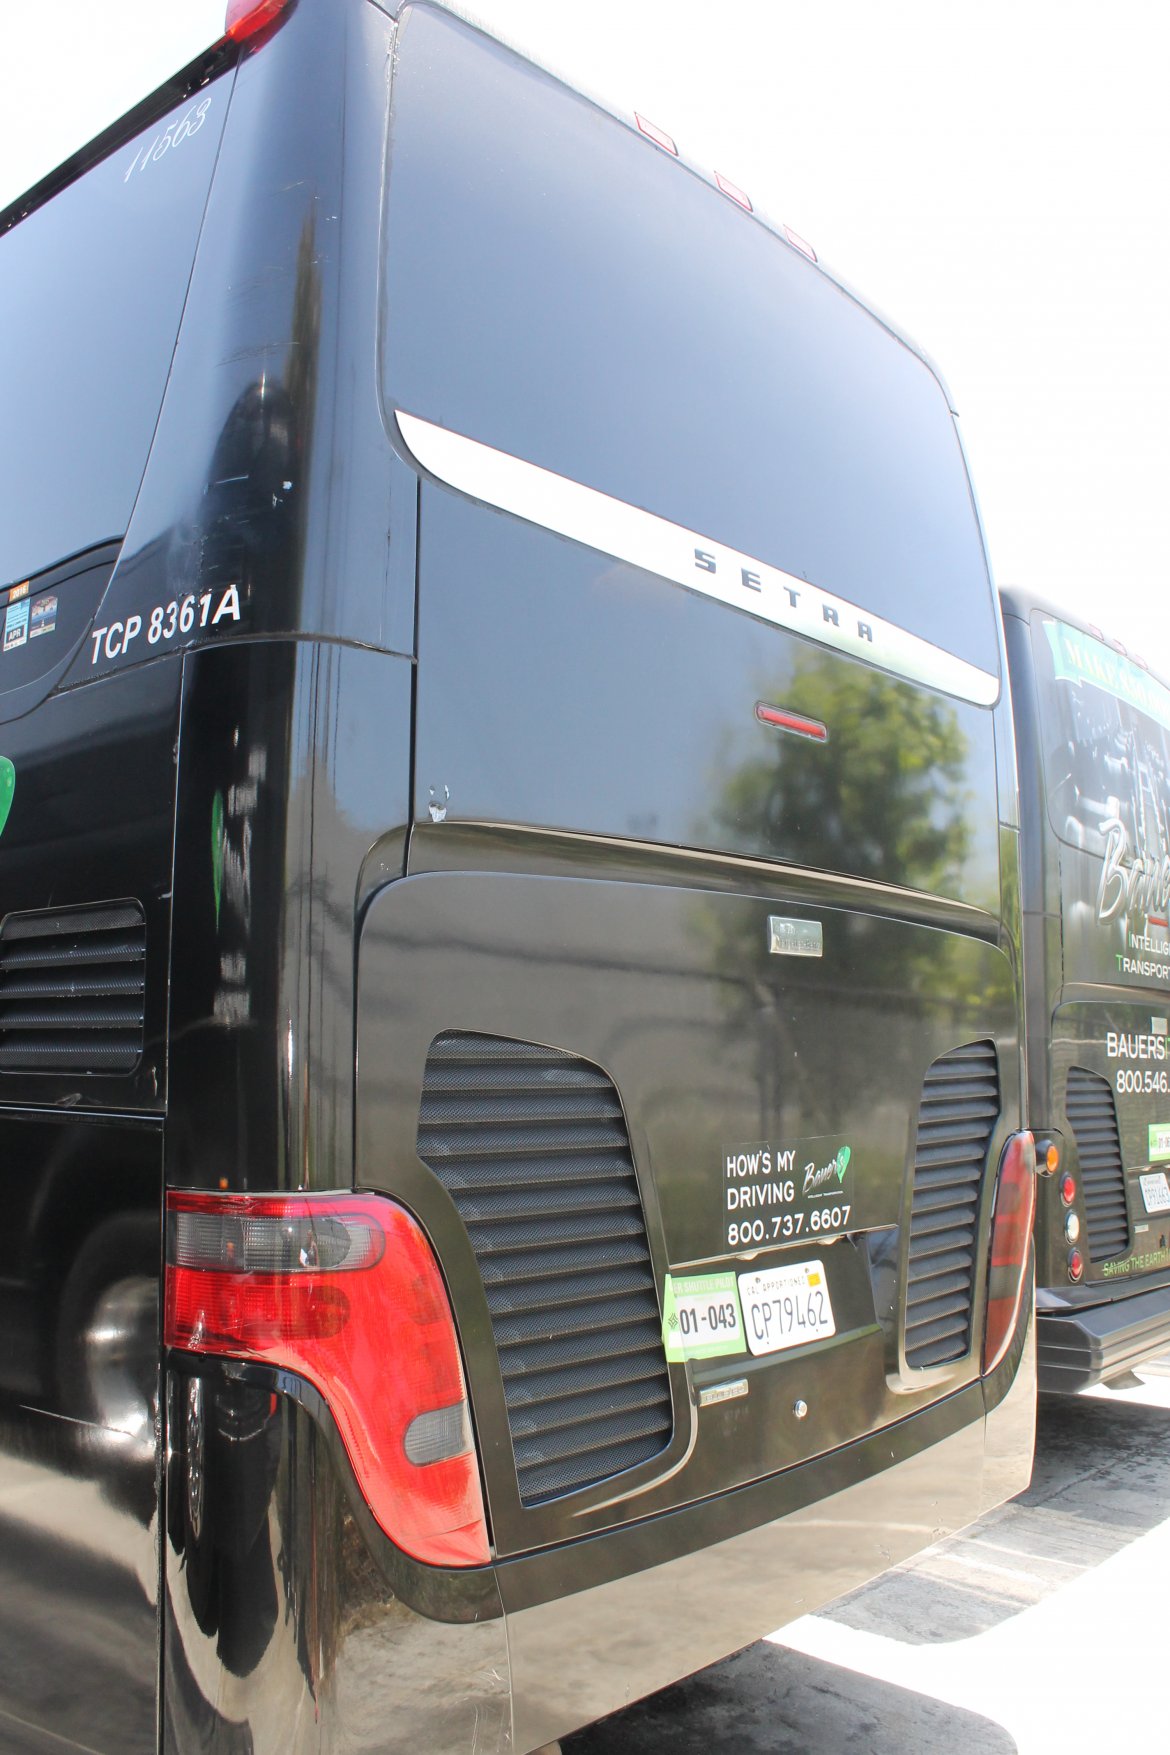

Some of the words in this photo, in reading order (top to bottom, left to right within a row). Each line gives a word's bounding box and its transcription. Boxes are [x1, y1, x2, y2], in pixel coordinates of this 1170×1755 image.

[124, 98, 212, 183] 11563
[694, 548, 873, 642] SETRA
[92, 615, 142, 664] TCP
[148, 584, 240, 644] 8361A
[1128, 931, 1170, 956] INTELLIG
[726, 1150, 771, 1178] HOW'S
[777, 1150, 796, 1172] MY
[727, 1180, 795, 1210] DRIVING
[727, 1205, 851, 1246] 800.737.6607
[1103, 1260, 1130, 1277] SAVING
[1131, 1255, 1145, 1269] THE
[679, 1303, 736, 1335] 01-043
[751, 1290, 829, 1340] CP79462
